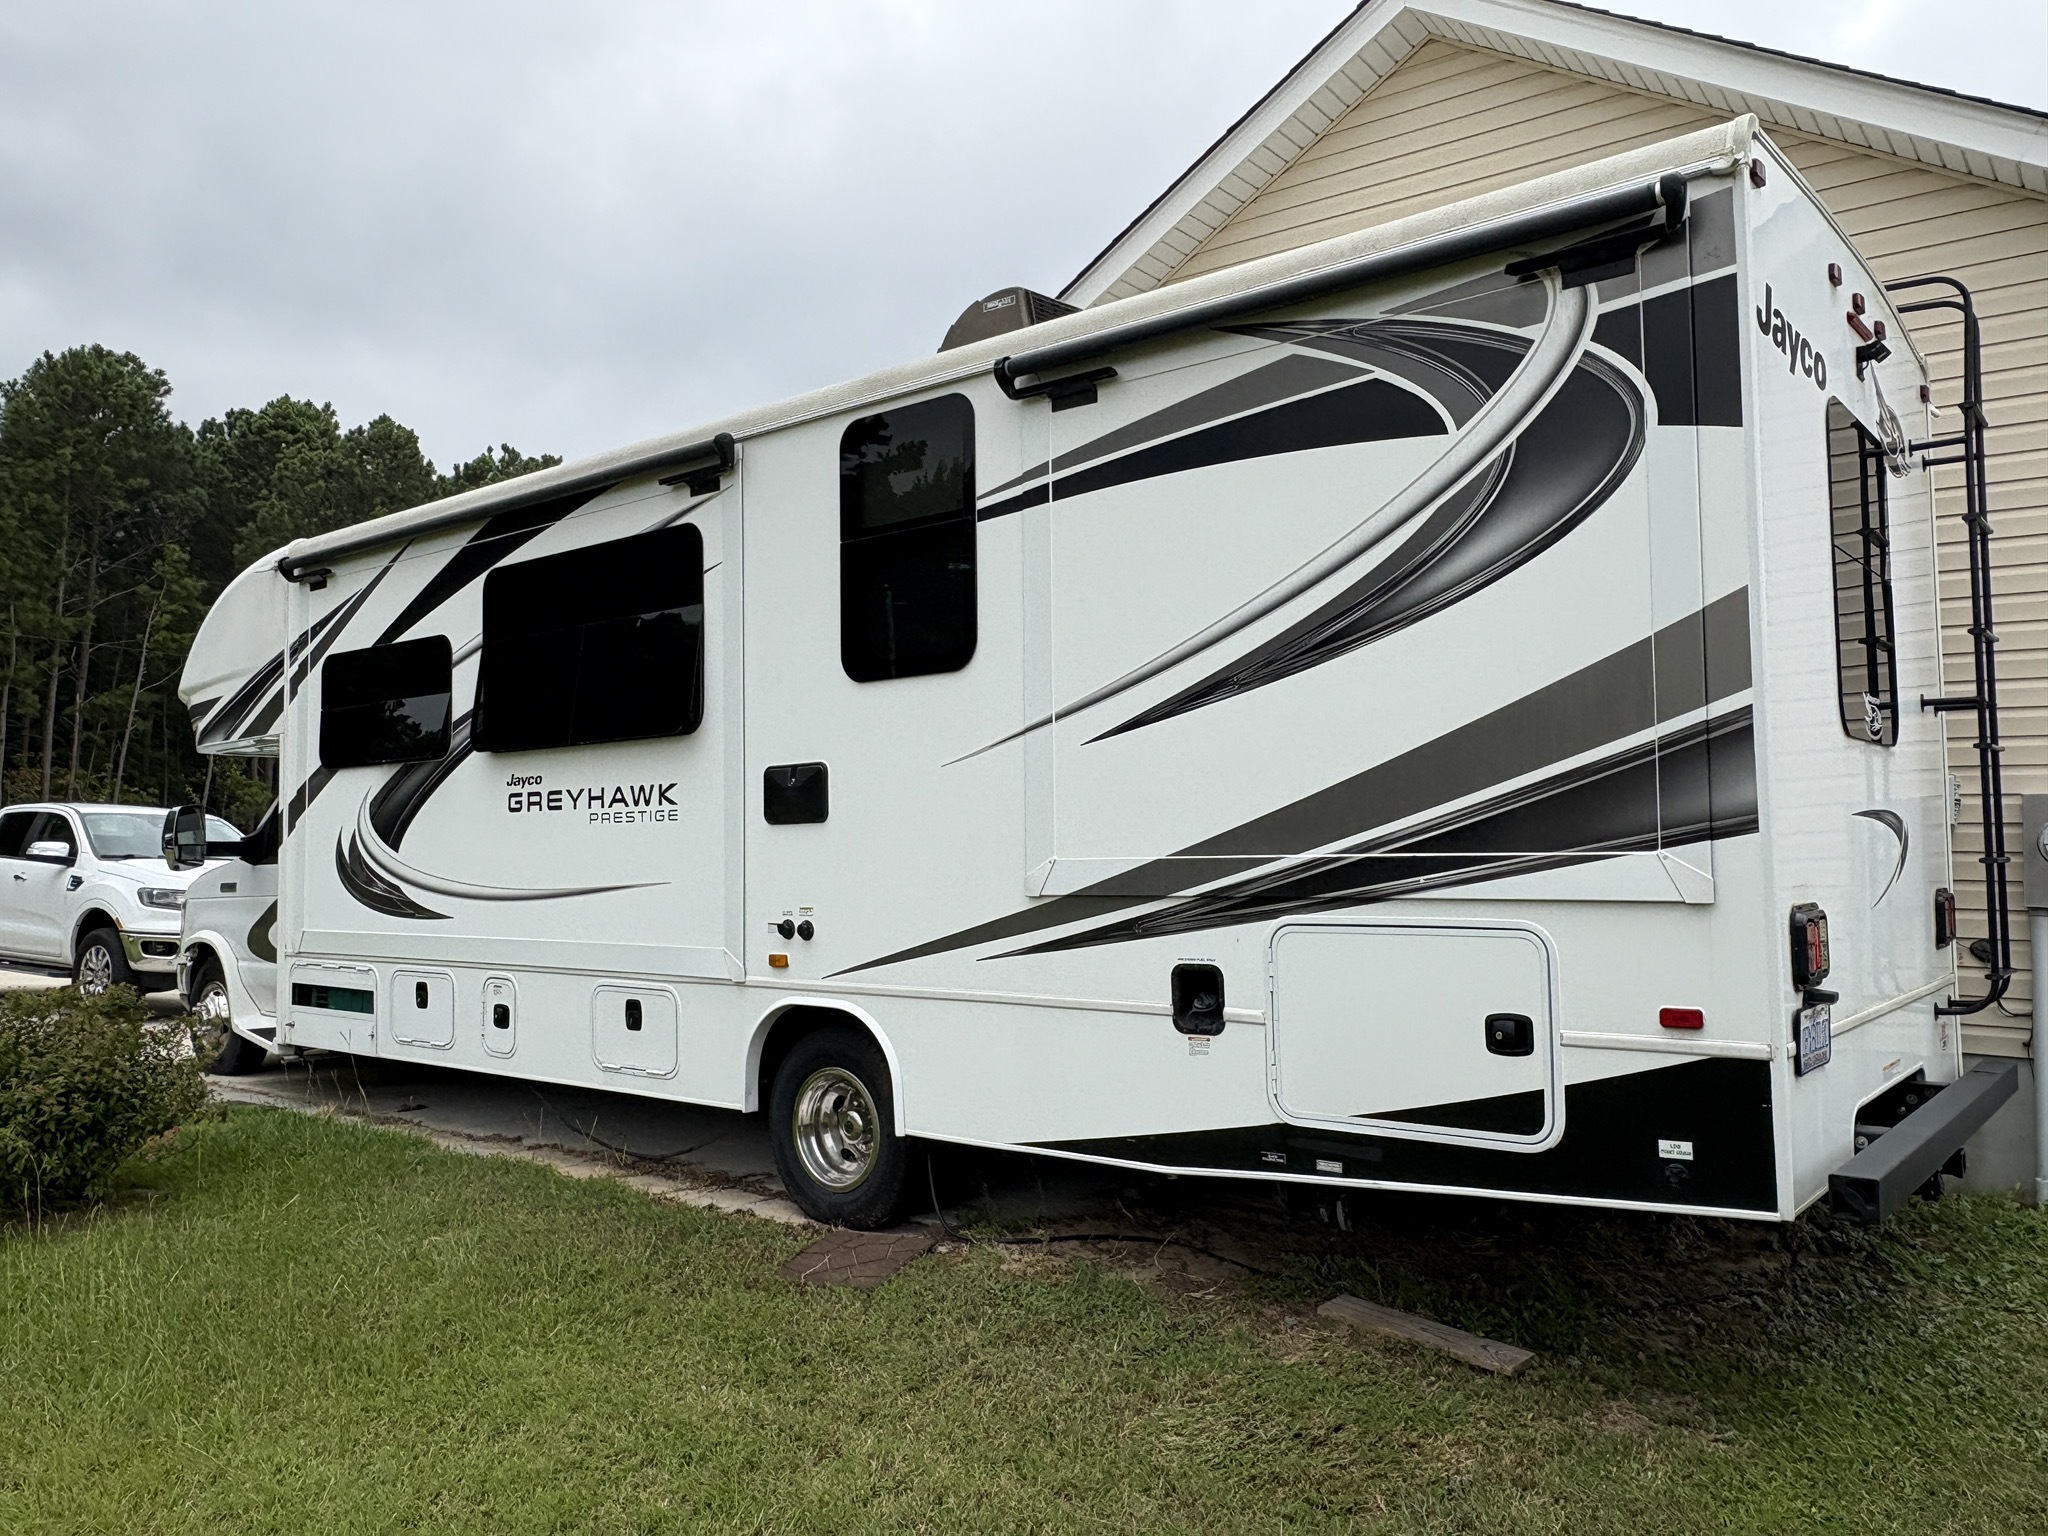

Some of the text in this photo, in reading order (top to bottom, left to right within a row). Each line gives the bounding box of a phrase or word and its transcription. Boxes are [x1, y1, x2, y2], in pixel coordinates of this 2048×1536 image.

[1756, 282, 1827, 391] Jayco
[506, 773, 543, 789] Jayco
[507, 782, 678, 813] GREYHAWK
[589, 809, 679, 825] PRESTIGE
